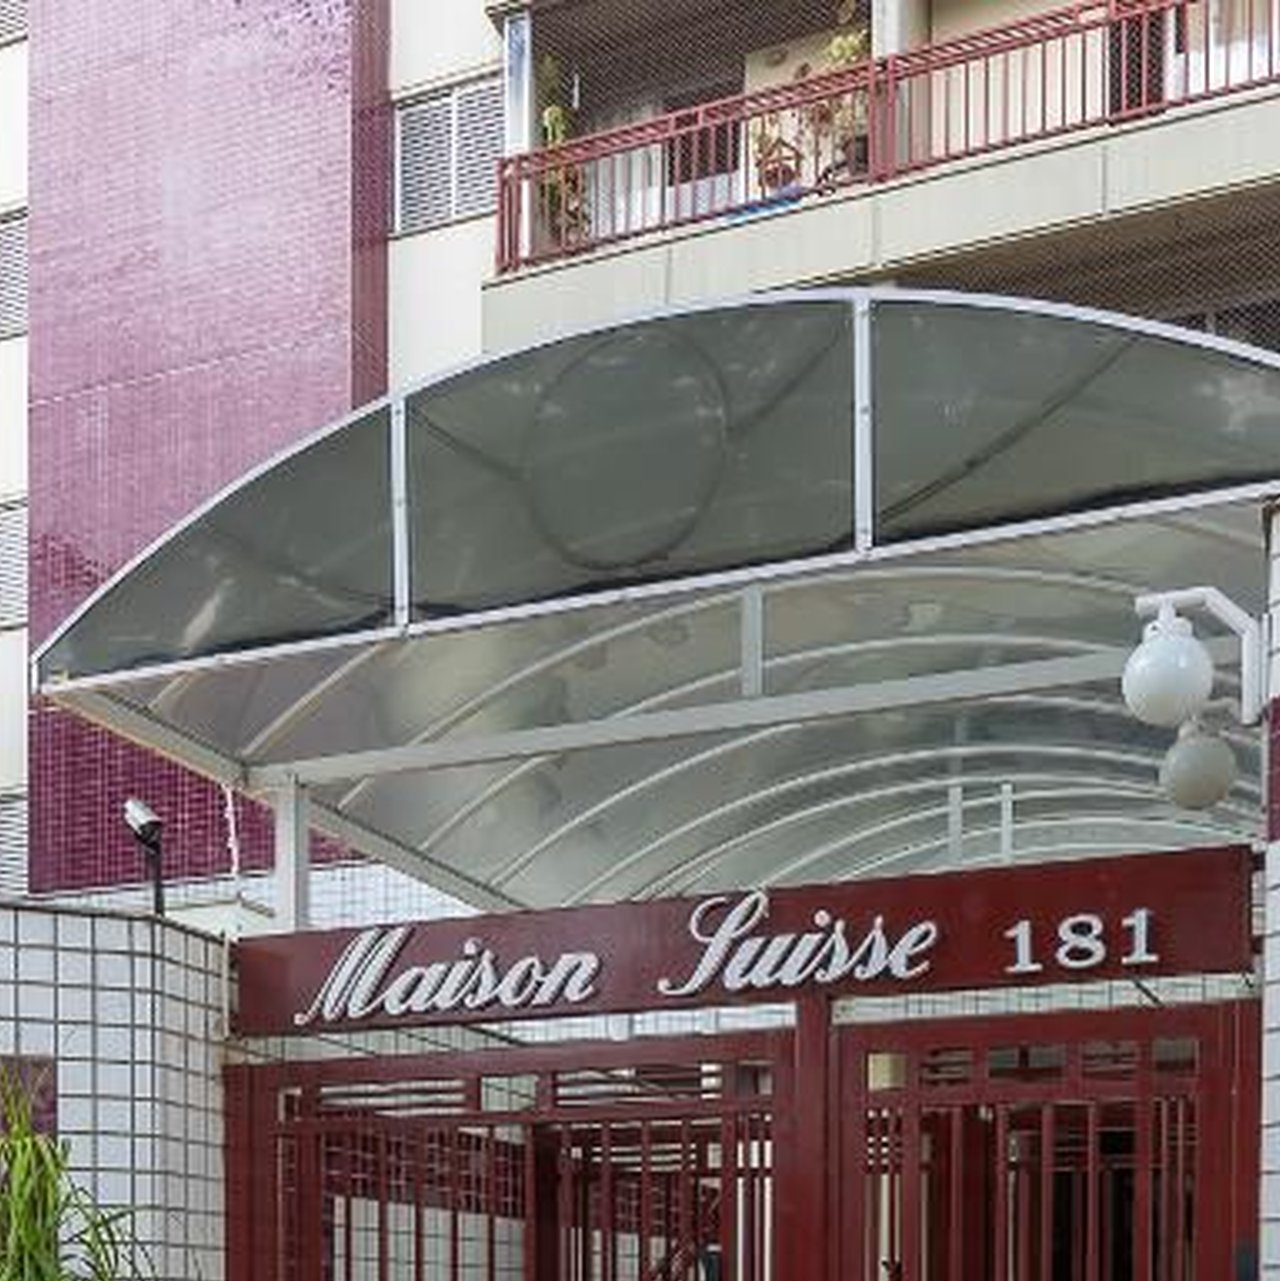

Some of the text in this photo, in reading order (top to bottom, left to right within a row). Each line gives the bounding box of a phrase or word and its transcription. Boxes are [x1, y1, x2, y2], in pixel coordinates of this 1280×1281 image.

[295, 889, 1161, 1024] Maison Suisse 181
